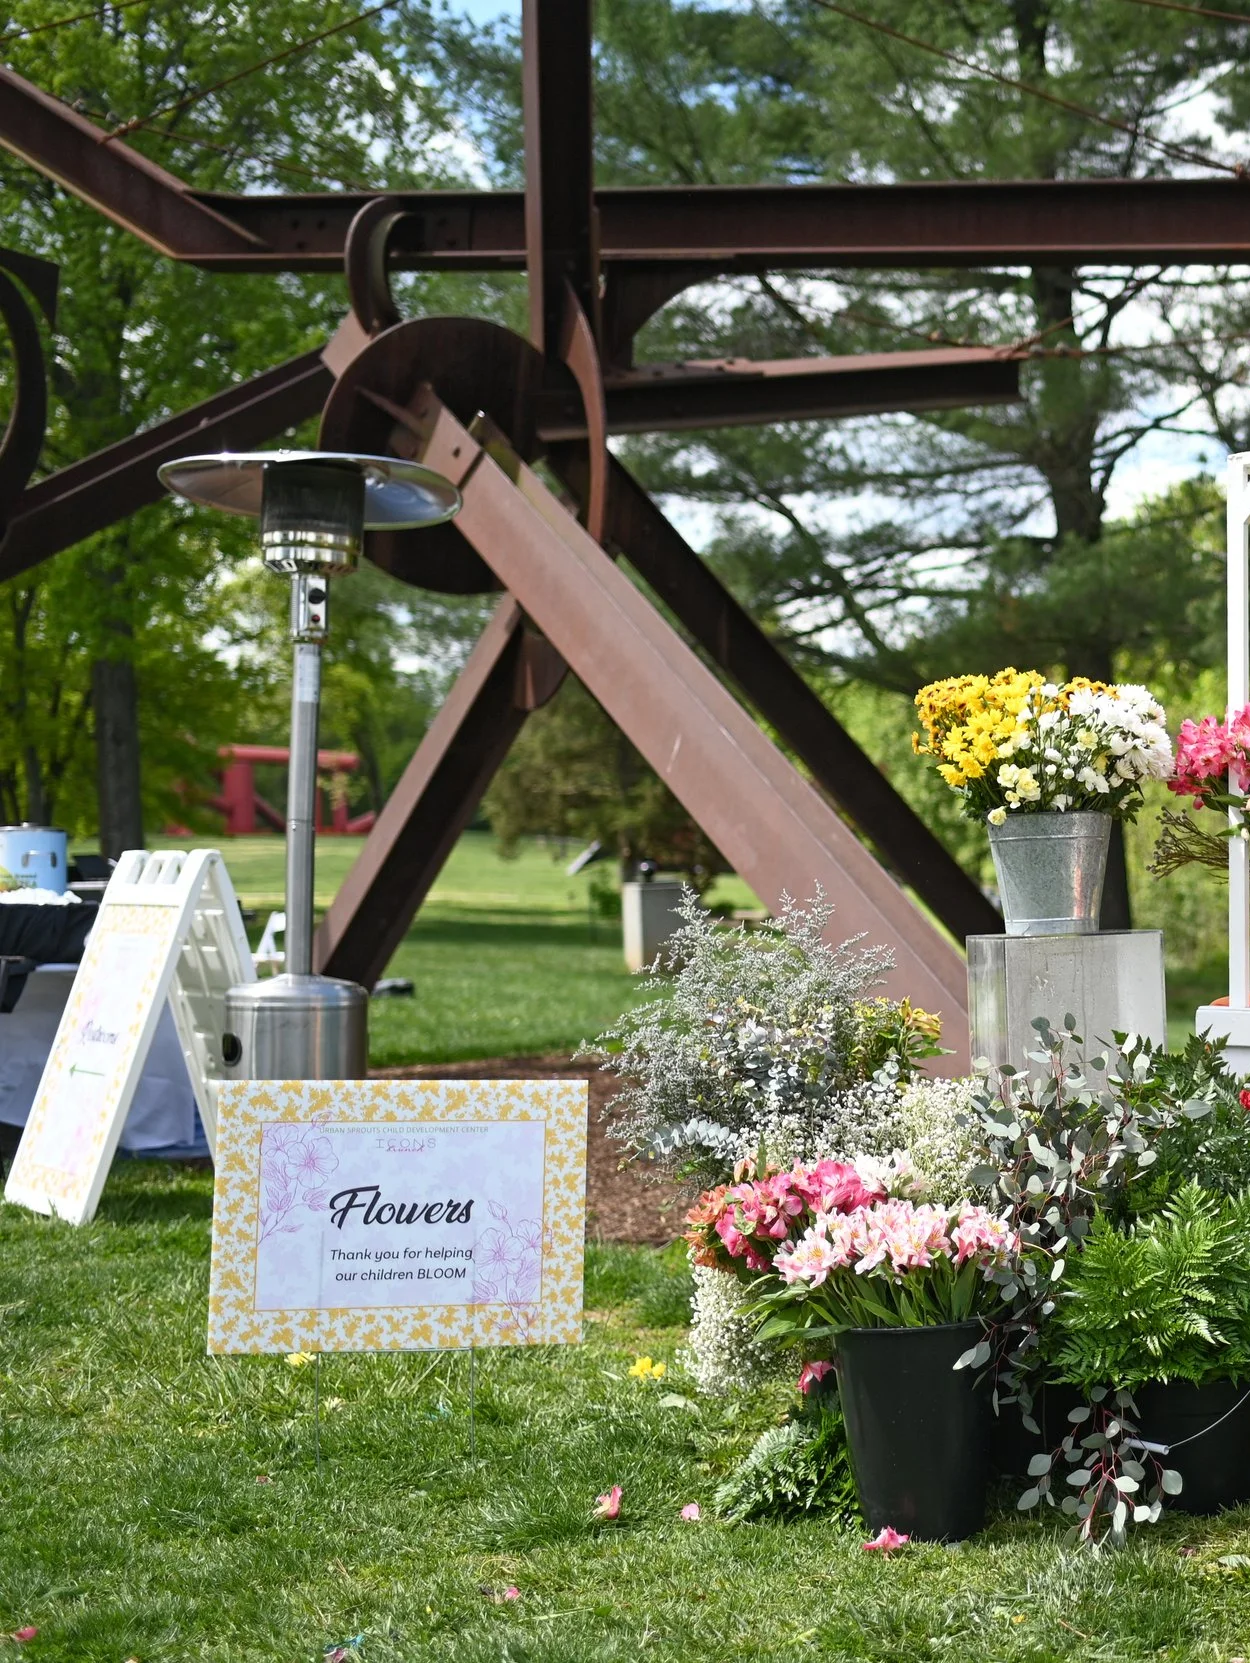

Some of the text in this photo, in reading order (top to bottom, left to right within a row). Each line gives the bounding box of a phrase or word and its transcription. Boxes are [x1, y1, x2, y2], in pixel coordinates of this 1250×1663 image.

[319, 1126, 347, 1134] URBAN
[347, 1126, 381, 1134] SPROUTS
[382, 1126, 405, 1134] CHILD
[406, 1126, 460, 1134] DEVELOPMENT
[375, 1138, 437, 1149] ICONS
[329, 1185, 475, 1230] Flowers
[330, 1246, 473, 1263] Thank you for helping
[335, 1267, 467, 1281] our children BLOOM
